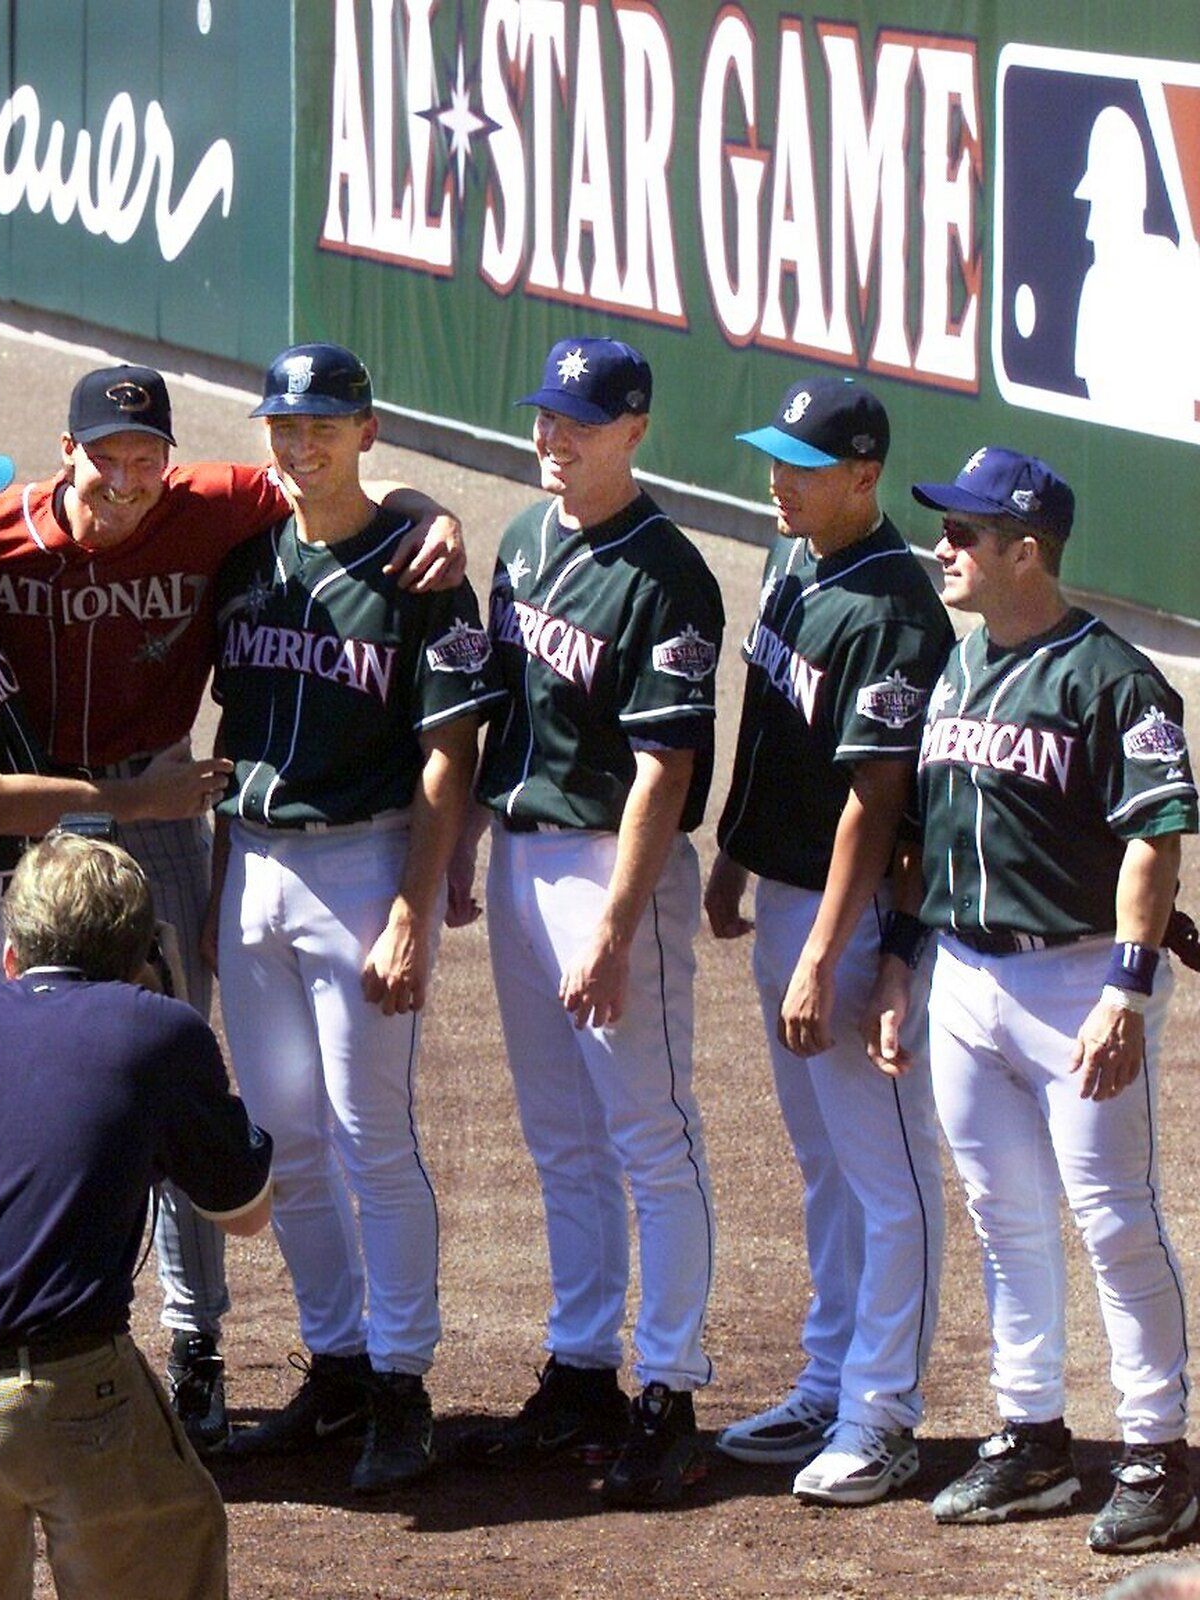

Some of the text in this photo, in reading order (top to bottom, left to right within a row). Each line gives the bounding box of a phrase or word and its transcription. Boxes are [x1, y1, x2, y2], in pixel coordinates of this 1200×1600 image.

[318, 0, 982, 396] ALL STAR GAME
[223, 620, 398, 704] AMERICAN
